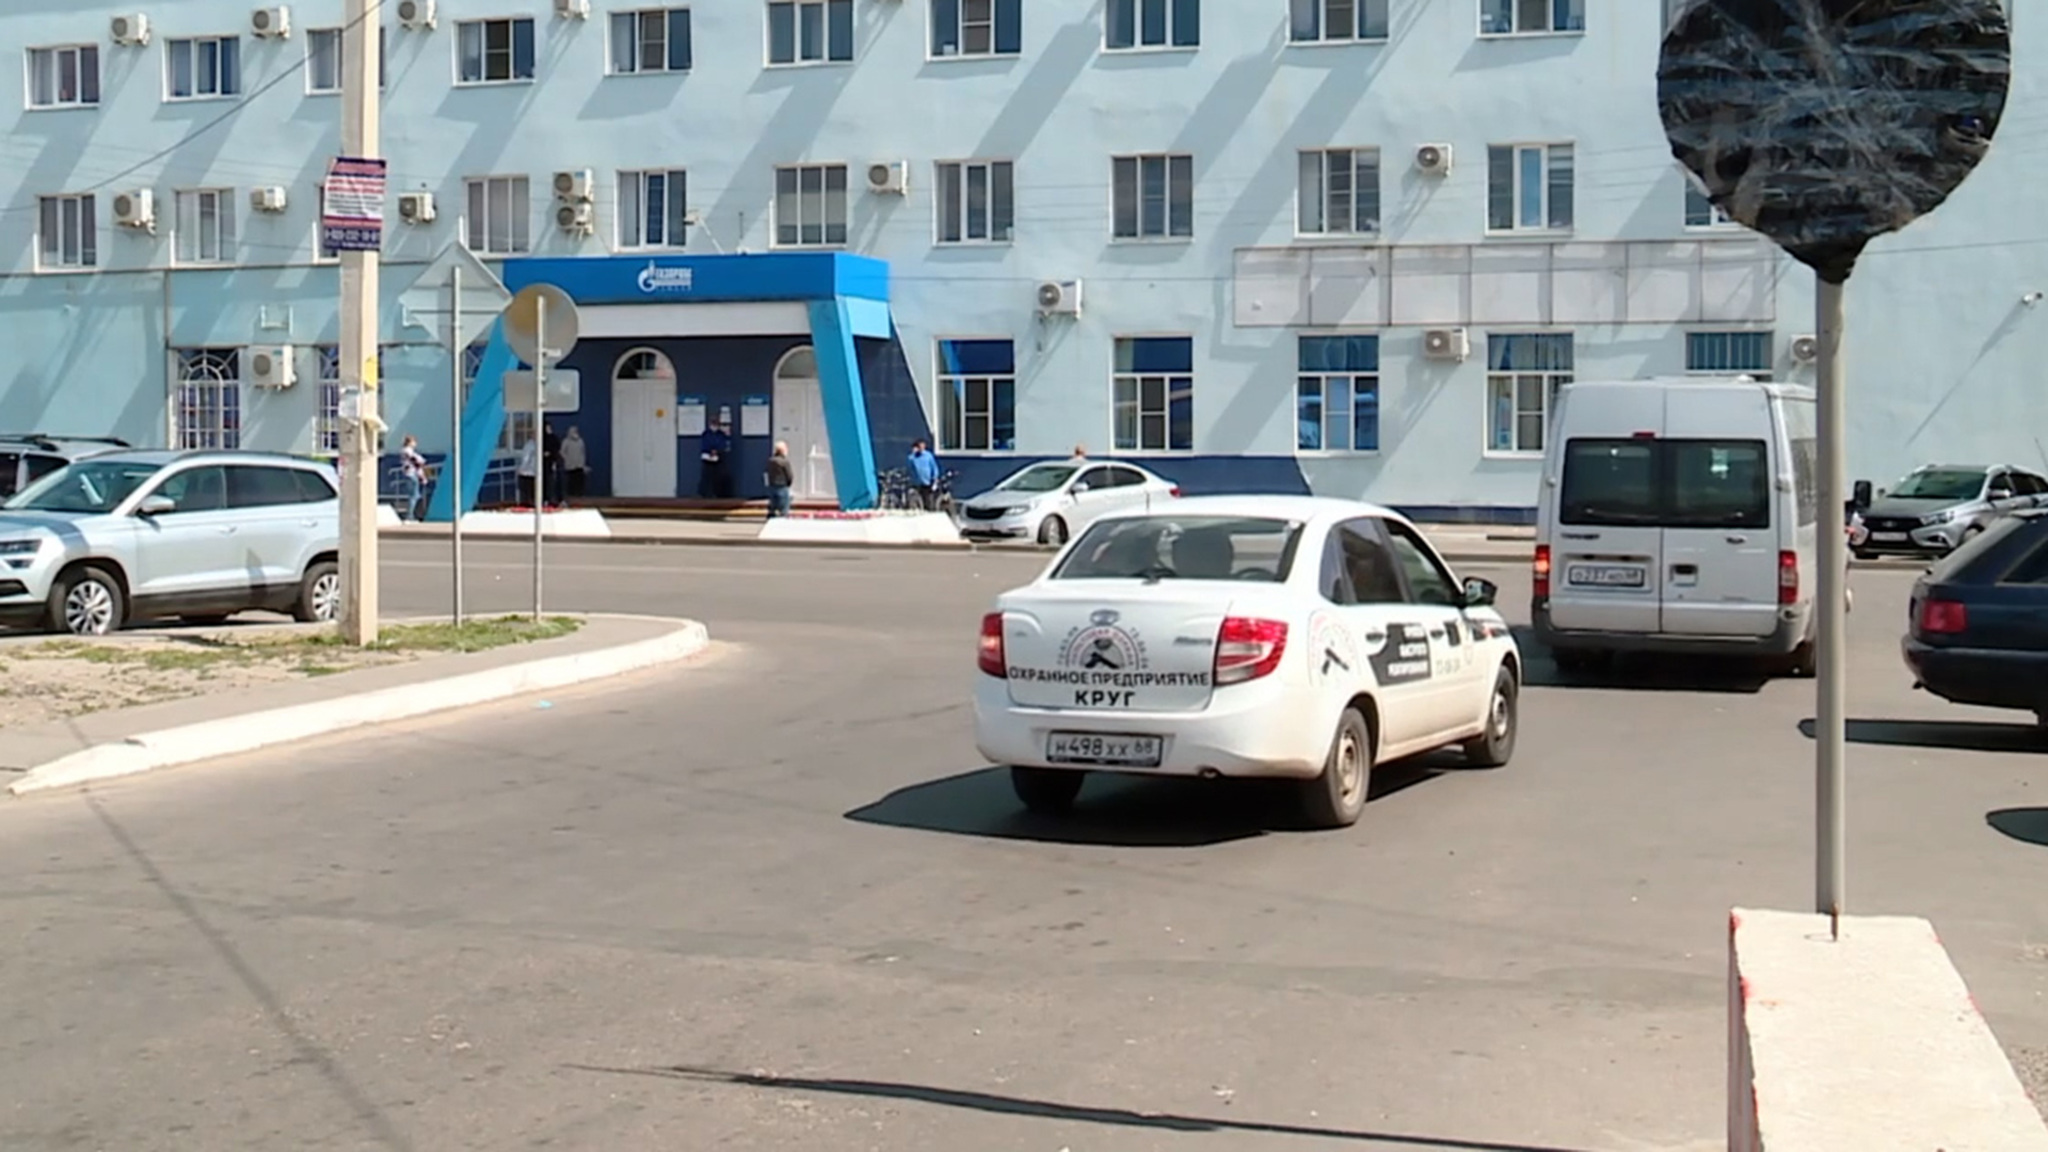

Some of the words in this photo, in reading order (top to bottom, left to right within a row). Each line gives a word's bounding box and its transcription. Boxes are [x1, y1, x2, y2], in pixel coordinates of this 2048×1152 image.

[1009, 667, 1089, 685] ОХРАННОЕ
[1092, 671, 1210, 688] ПРЕДПРИЯТИЕ
[1075, 690, 1136, 706] КРУГ
